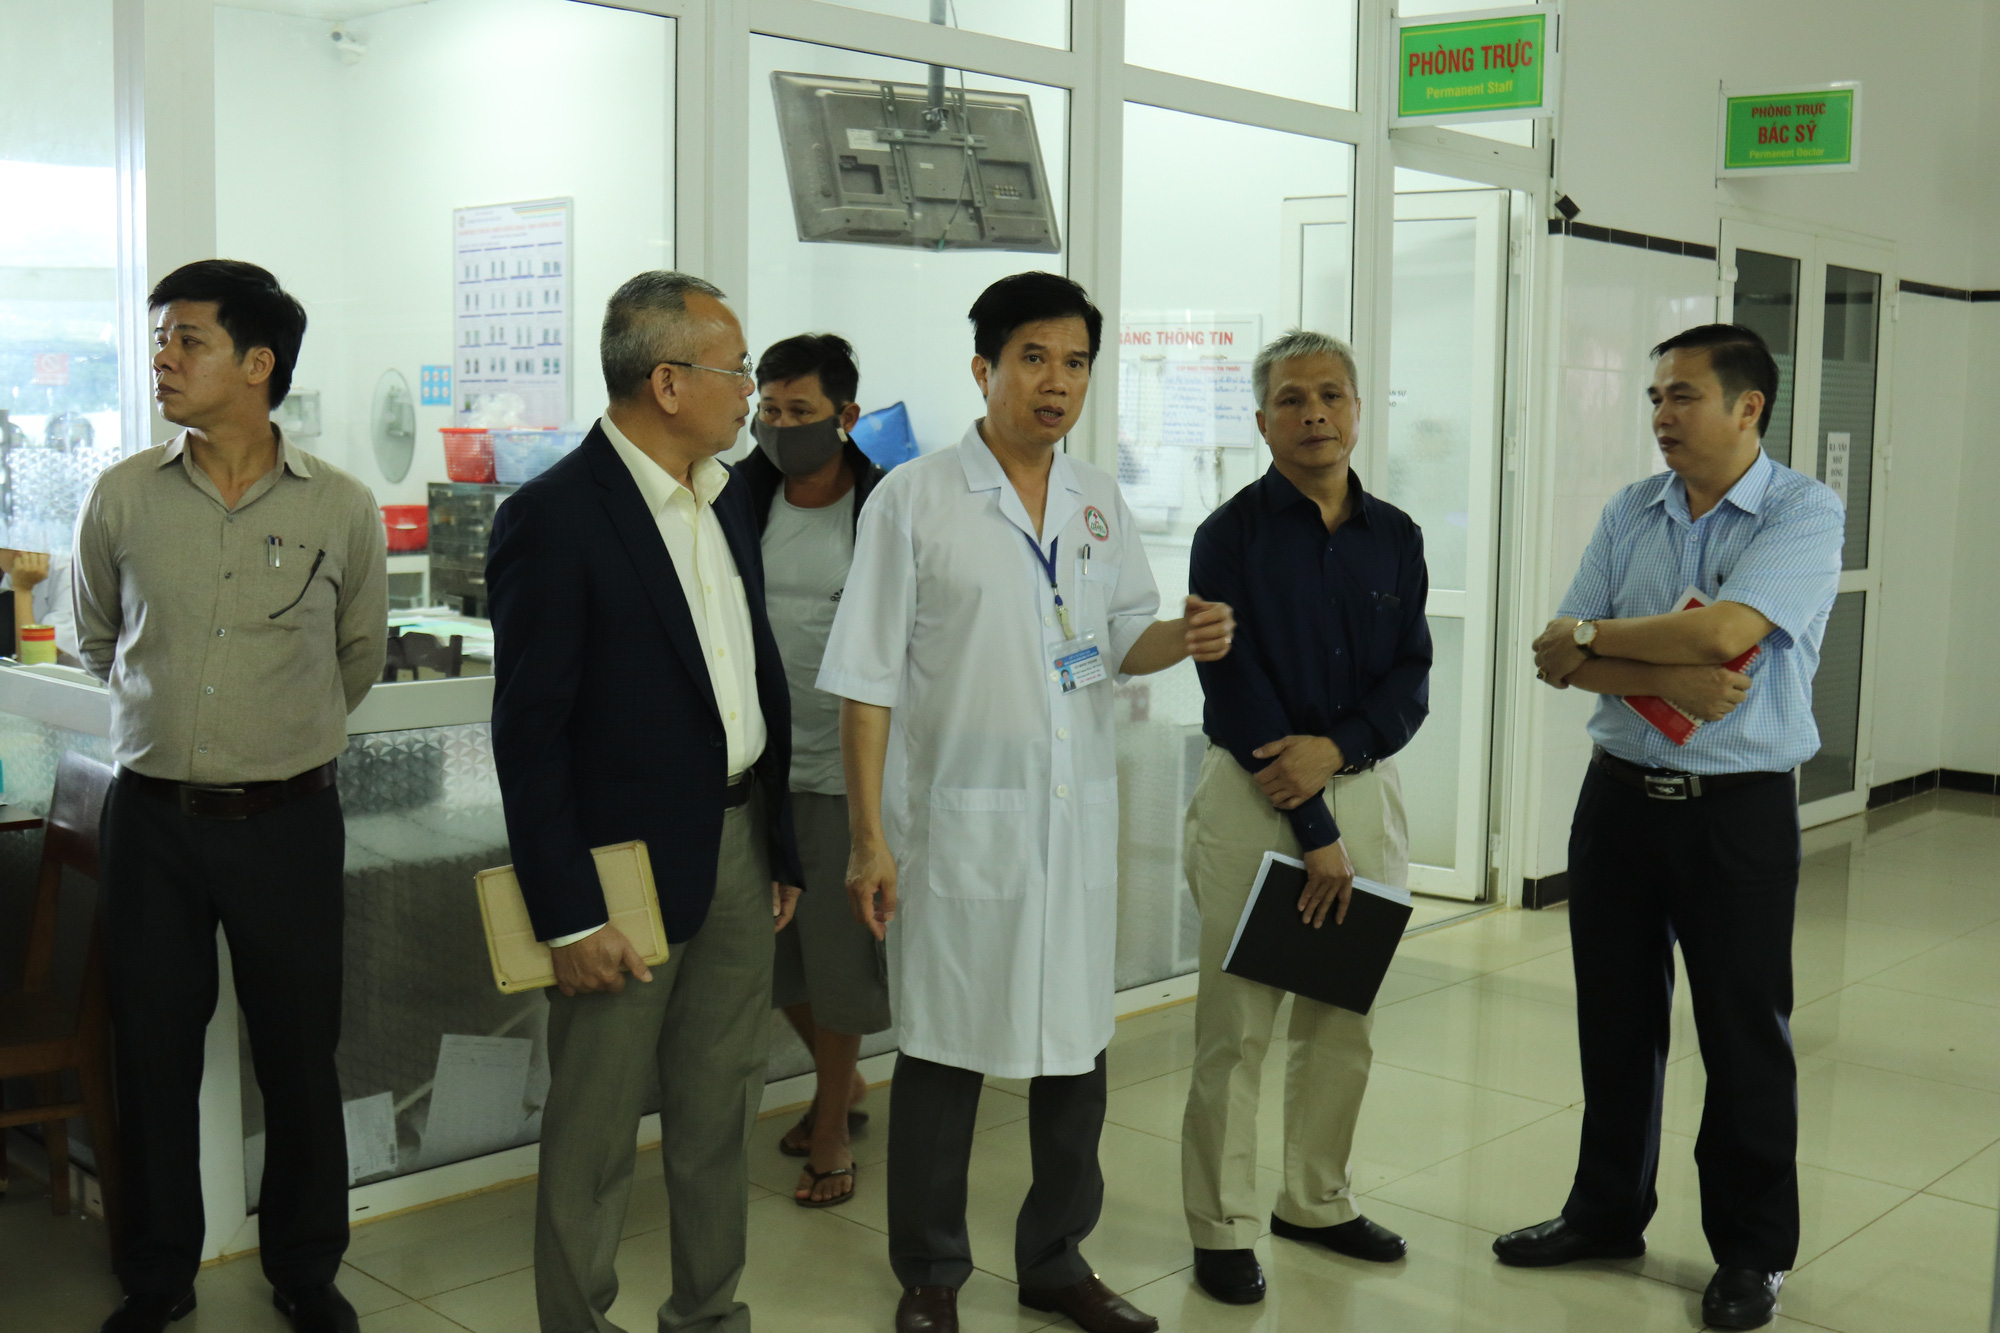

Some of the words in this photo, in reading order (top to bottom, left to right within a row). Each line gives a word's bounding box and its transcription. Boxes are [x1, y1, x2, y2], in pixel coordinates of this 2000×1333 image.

[1409, 44, 1474, 77] PHÒNG
[1481, 38, 1533, 73] TRỰC
[1426, 83, 1484, 99] Permanent
[1487, 80, 1513, 93] Staff
[1752, 104, 1792, 118] PHÒNG
[1796, 103, 1827, 117] TRỰC
[1758, 122, 1790, 144] BÁC
[1795, 120, 1817, 143] SỸ
[1749, 149, 1794, 159] Permanent
[1797, 147, 1825, 157] Doctor
[1156, 327, 1205, 345] THÔNG
[1209, 331, 1233, 345] TIN
